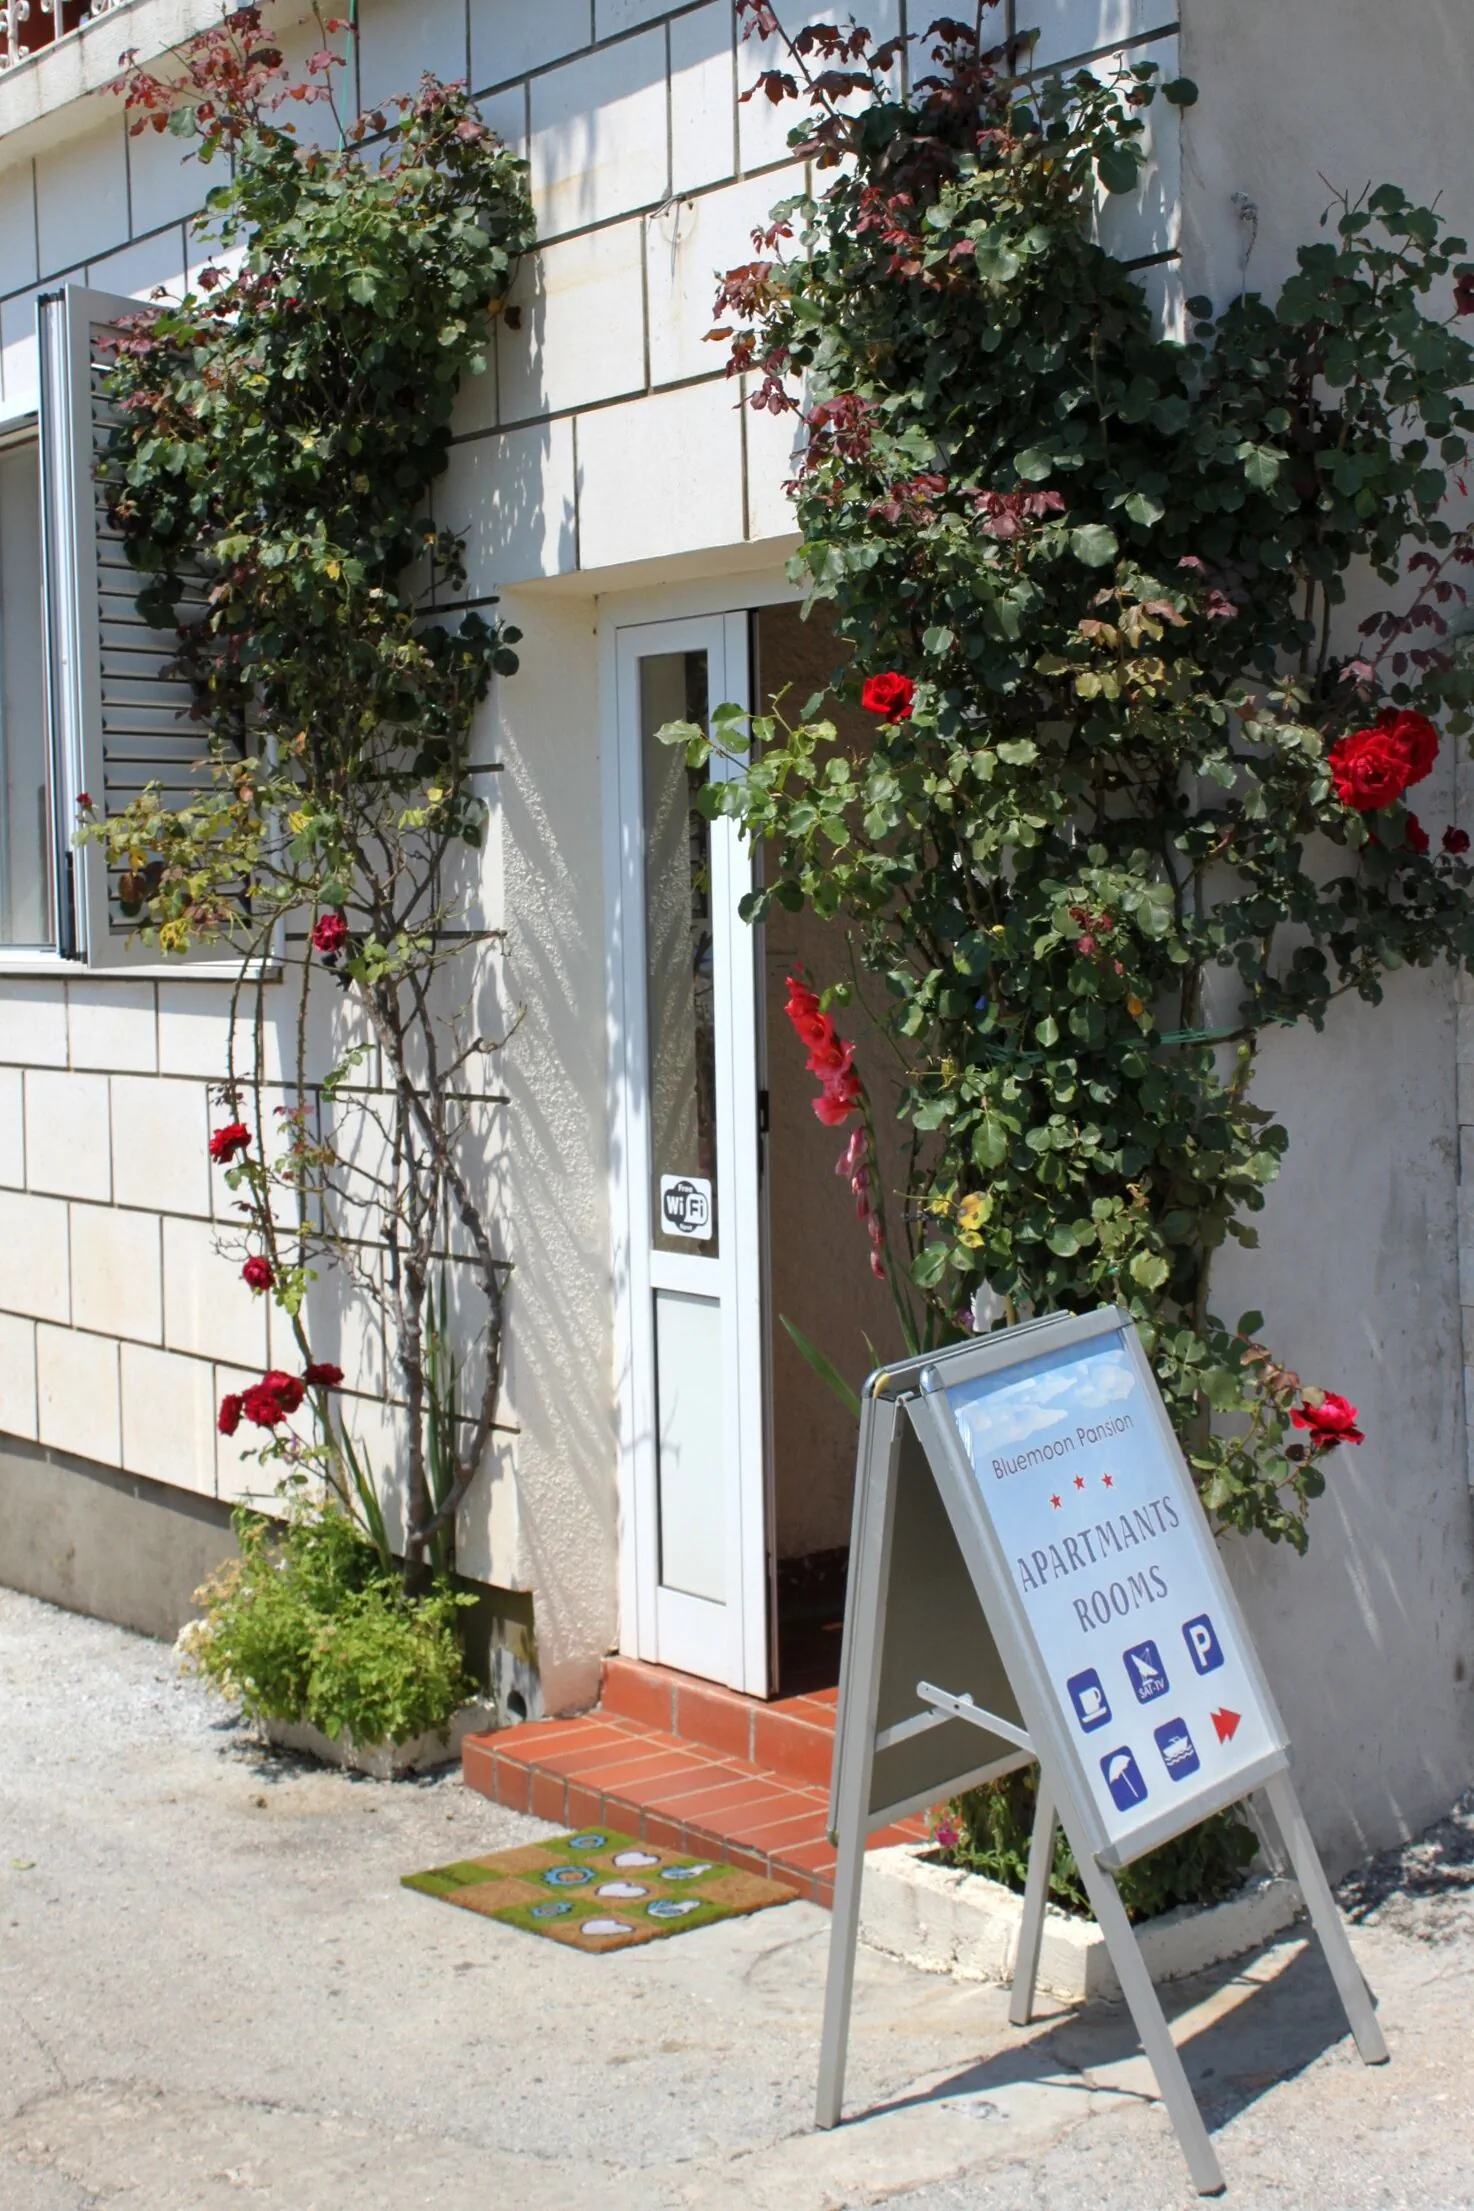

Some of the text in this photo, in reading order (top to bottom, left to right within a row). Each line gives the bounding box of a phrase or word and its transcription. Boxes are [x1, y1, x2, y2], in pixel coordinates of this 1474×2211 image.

[678, 1183, 693, 1193] Free
[992, 1415, 1134, 1480] Bluemoon Pansion
[1017, 1495, 1180, 1593] APARTMANTS
[1072, 1565, 1169, 1633] ROOMS
[1188, 1624, 1212, 1667] P
[1138, 1678, 1165, 1700] SAT-TV
